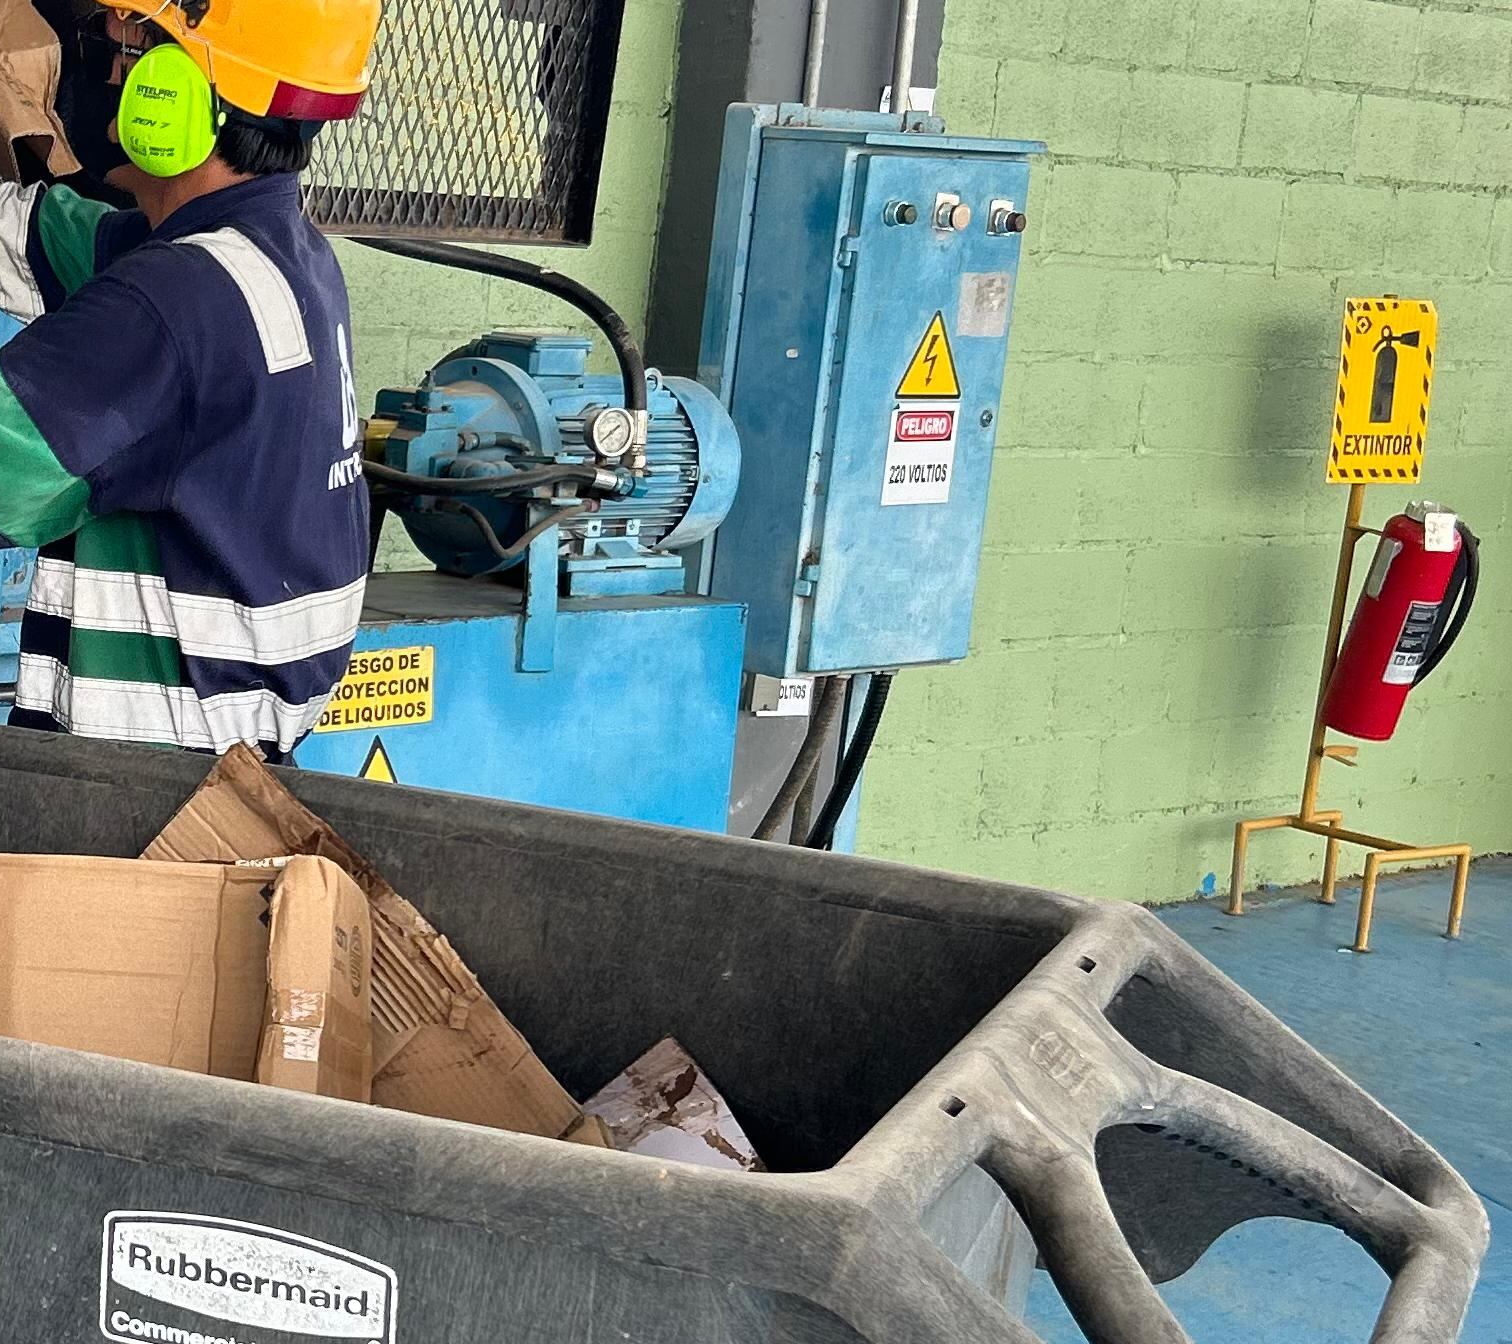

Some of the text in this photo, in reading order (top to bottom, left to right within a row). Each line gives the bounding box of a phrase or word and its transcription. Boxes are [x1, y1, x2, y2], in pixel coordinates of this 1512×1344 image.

[900, 416, 948, 436] PELIGRO
[1343, 434, 1413, 456] EXTINTOR
[888, 463, 948, 484] 220 VOLTIOS
[348, 653, 420, 676] ESGO DE
[331, 676, 429, 701] ROYECCION
[778, 684, 807, 700] OLTIOS
[319, 701, 426, 727] DE LIQUIDOS
[128, 1242, 369, 1317] Rubbermaid
